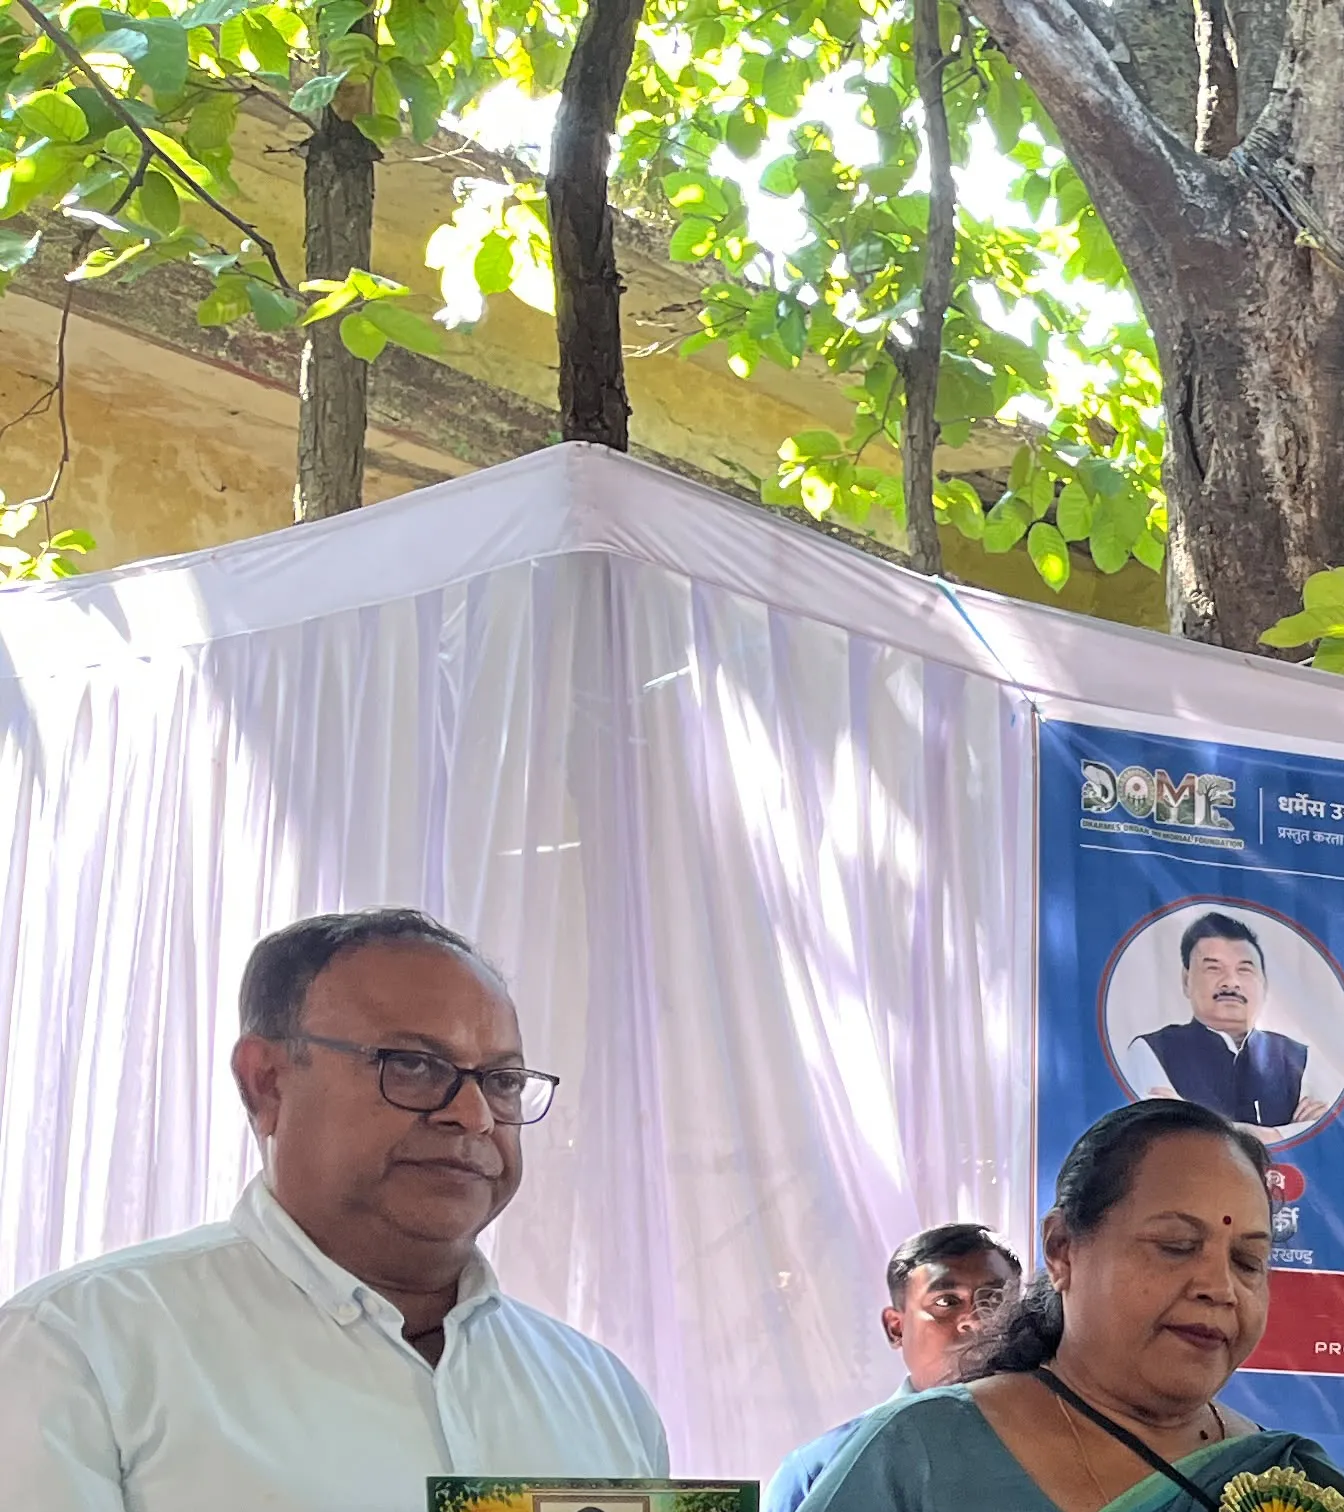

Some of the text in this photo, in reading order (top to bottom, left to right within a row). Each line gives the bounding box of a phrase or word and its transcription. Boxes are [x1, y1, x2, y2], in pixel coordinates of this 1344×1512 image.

[1278, 793, 1325, 818] धर्मेस
[1278, 826, 1310, 845] प्रस्तुत
[1313, 830, 1343, 846] करता
[1272, 1206, 1299, 1233] र्की
[1271, 1248, 1314, 1264] रखण्ड
